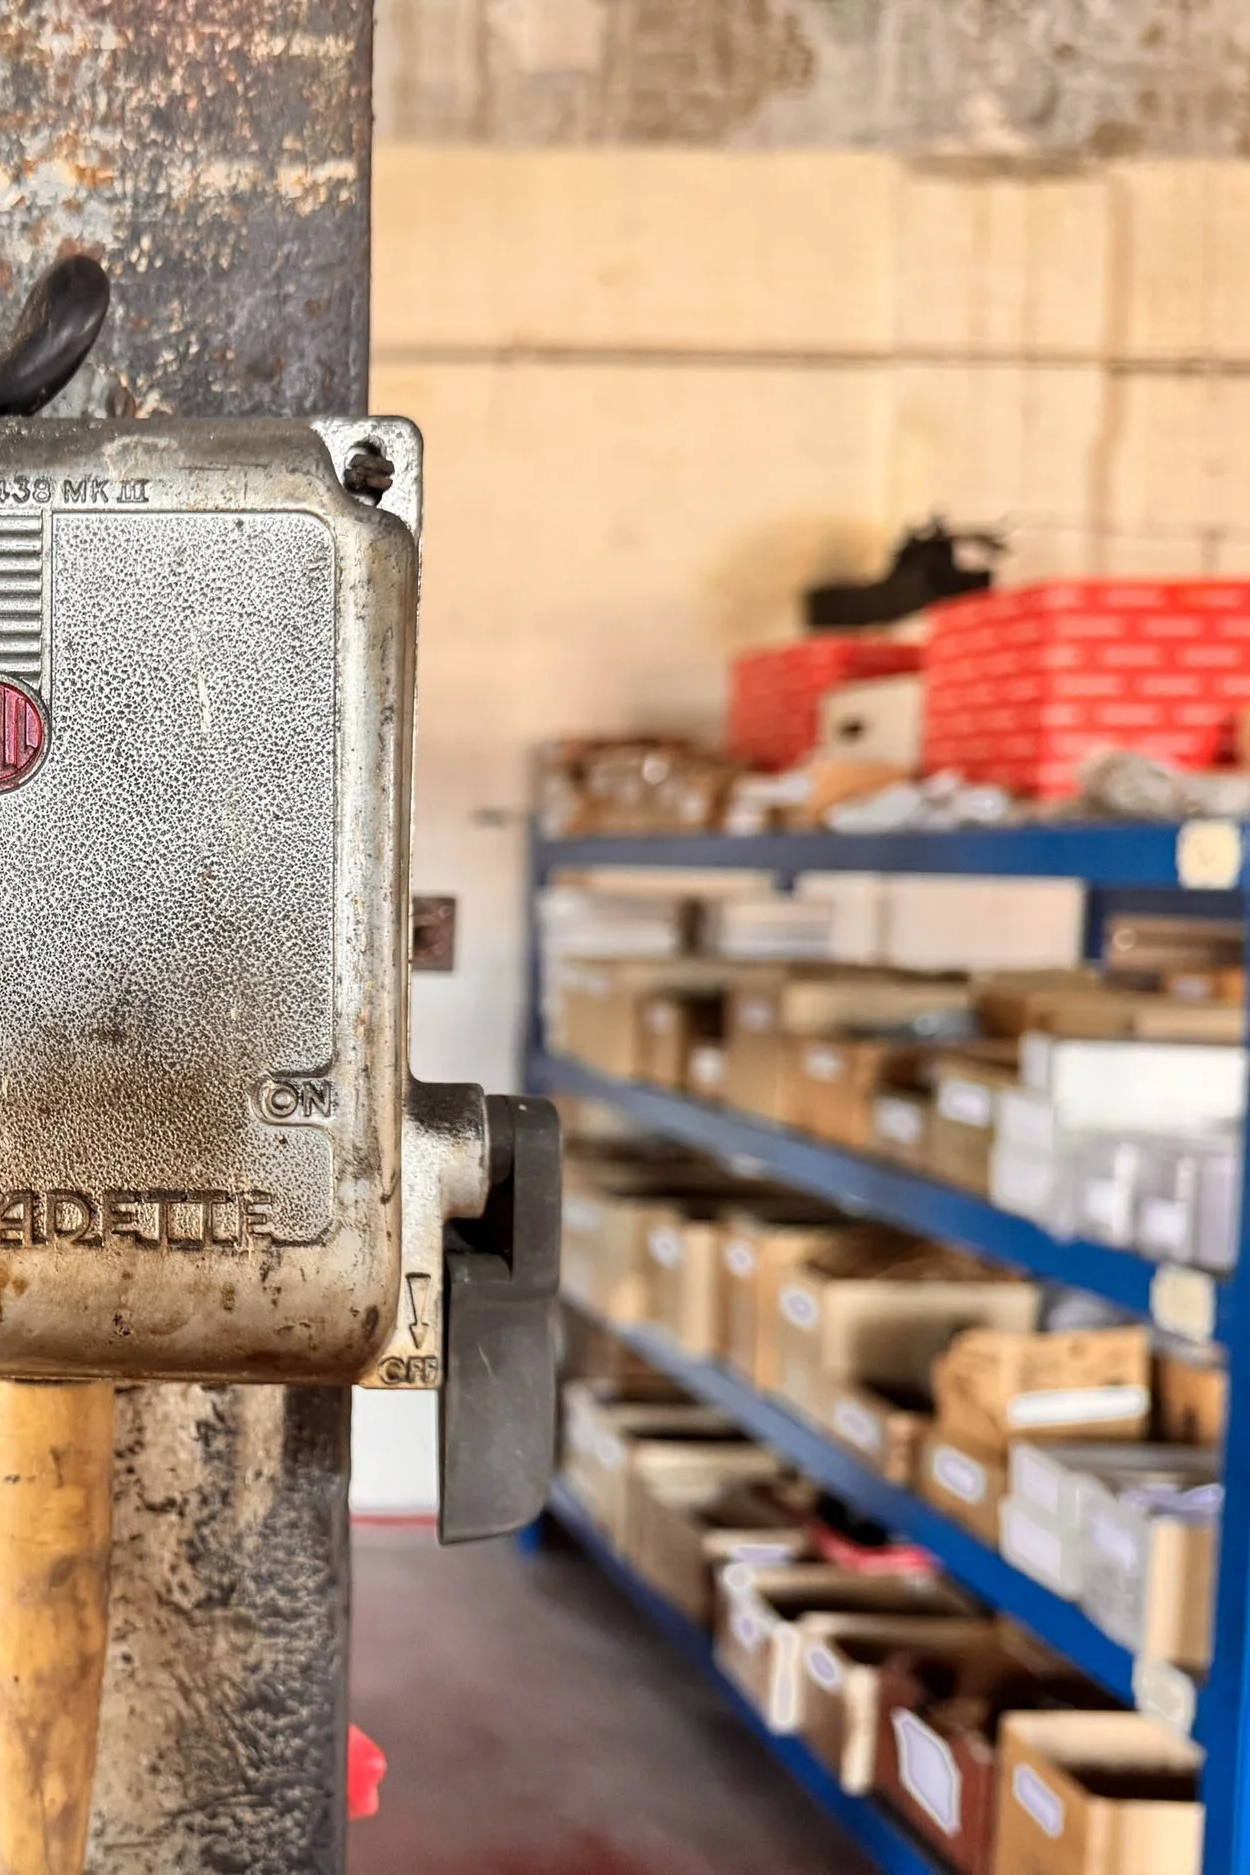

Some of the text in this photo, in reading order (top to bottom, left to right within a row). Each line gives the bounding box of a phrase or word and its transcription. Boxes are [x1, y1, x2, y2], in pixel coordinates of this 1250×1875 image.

[63, 478, 109, 504] MK
[264, 1080, 332, 1119] ON
[379, 1355, 438, 1385] OFF
